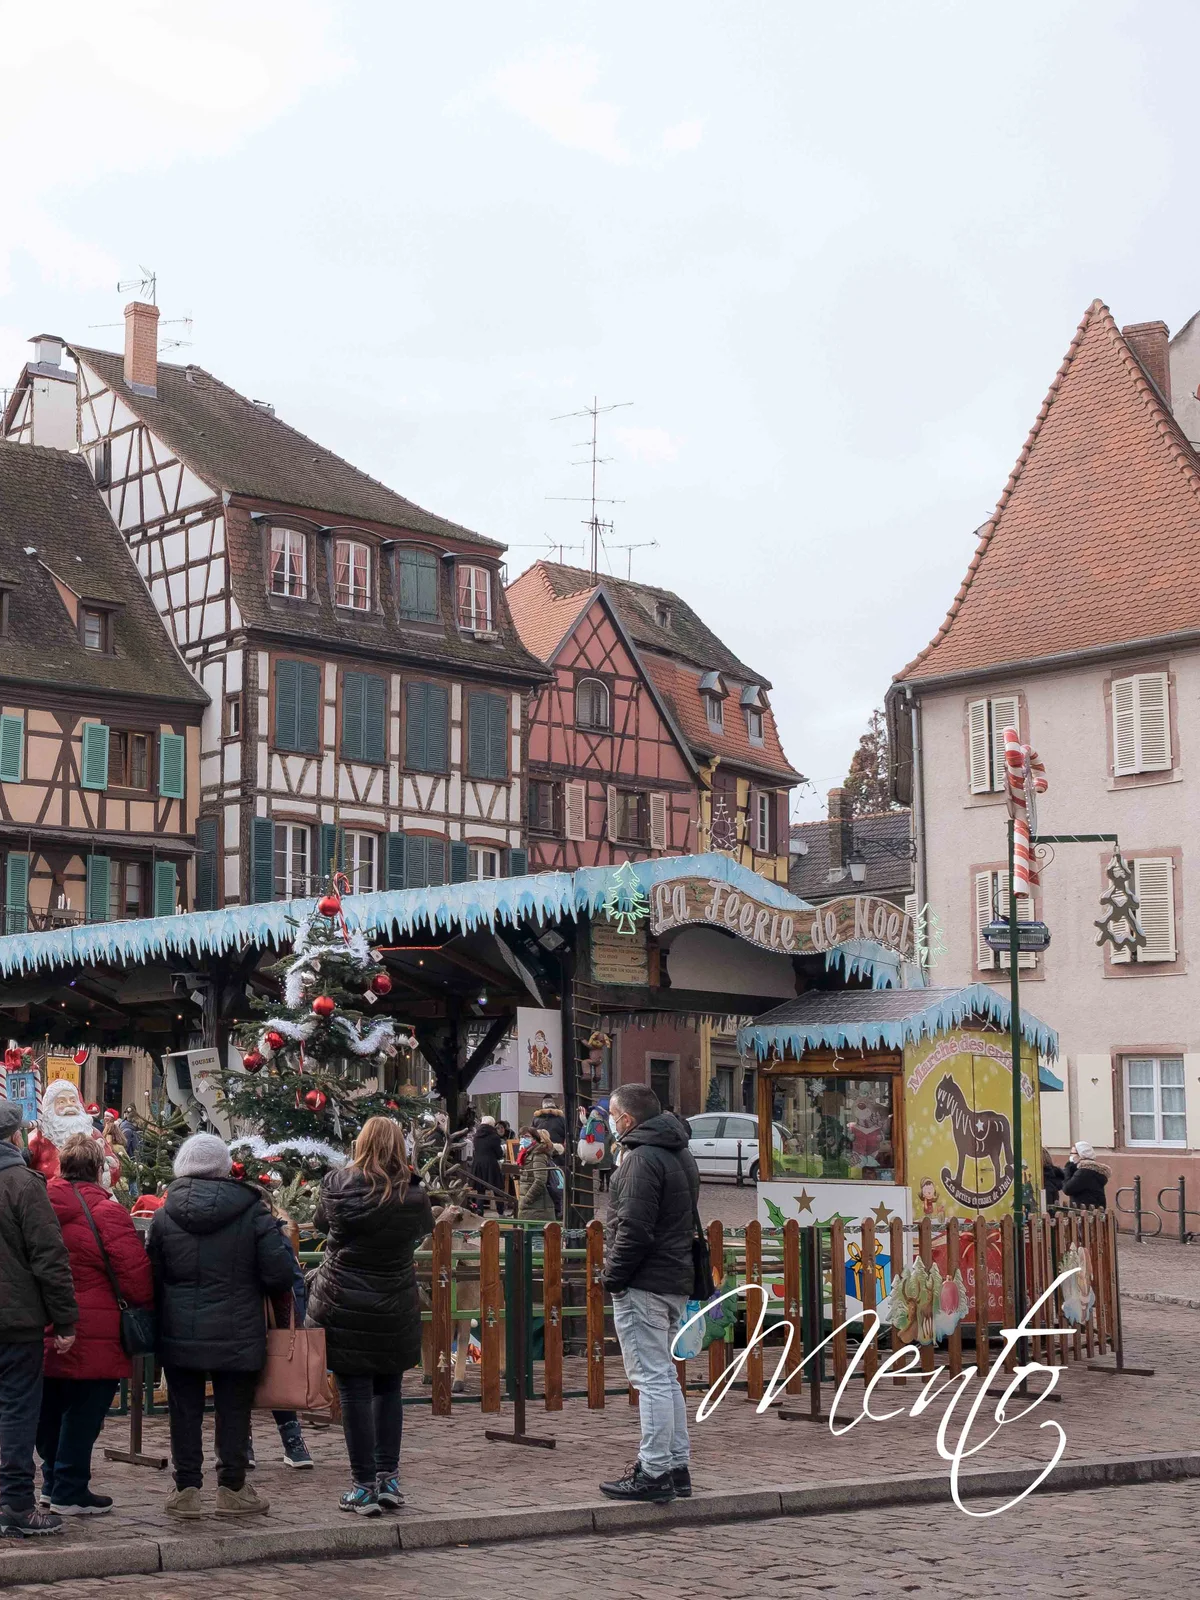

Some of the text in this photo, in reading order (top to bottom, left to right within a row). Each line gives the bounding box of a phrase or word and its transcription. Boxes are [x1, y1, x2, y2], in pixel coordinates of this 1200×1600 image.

[655, 883, 690, 931] La
[811, 908, 840, 951] de
[191, 1057, 215, 1066] SOURIEZ
[908, 1036, 959, 1094] Marché
[960, 1034, 985, 1052] des
